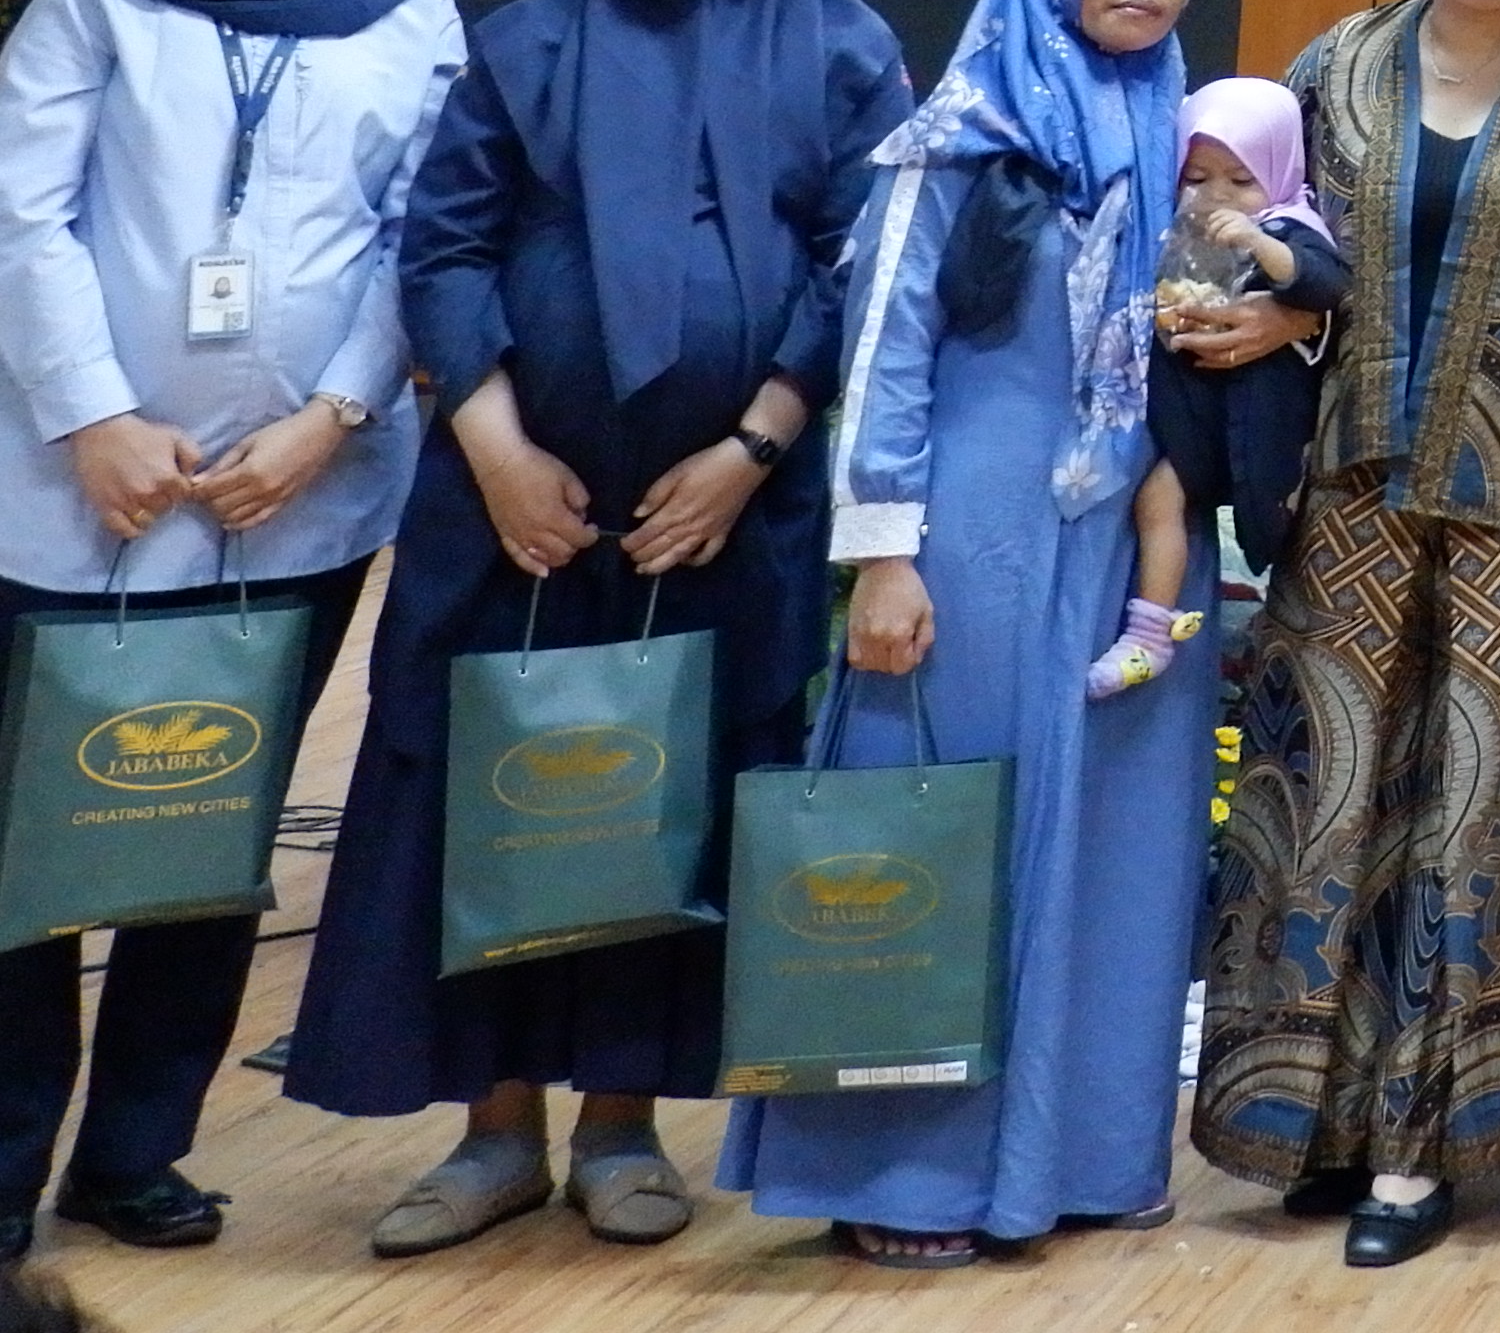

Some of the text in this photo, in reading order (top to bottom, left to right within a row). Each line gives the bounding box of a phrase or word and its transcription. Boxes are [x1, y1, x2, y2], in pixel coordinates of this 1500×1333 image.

[105, 750, 230, 777] JABABEKA
[71, 796, 252, 826] CREATING NEW CITIES
